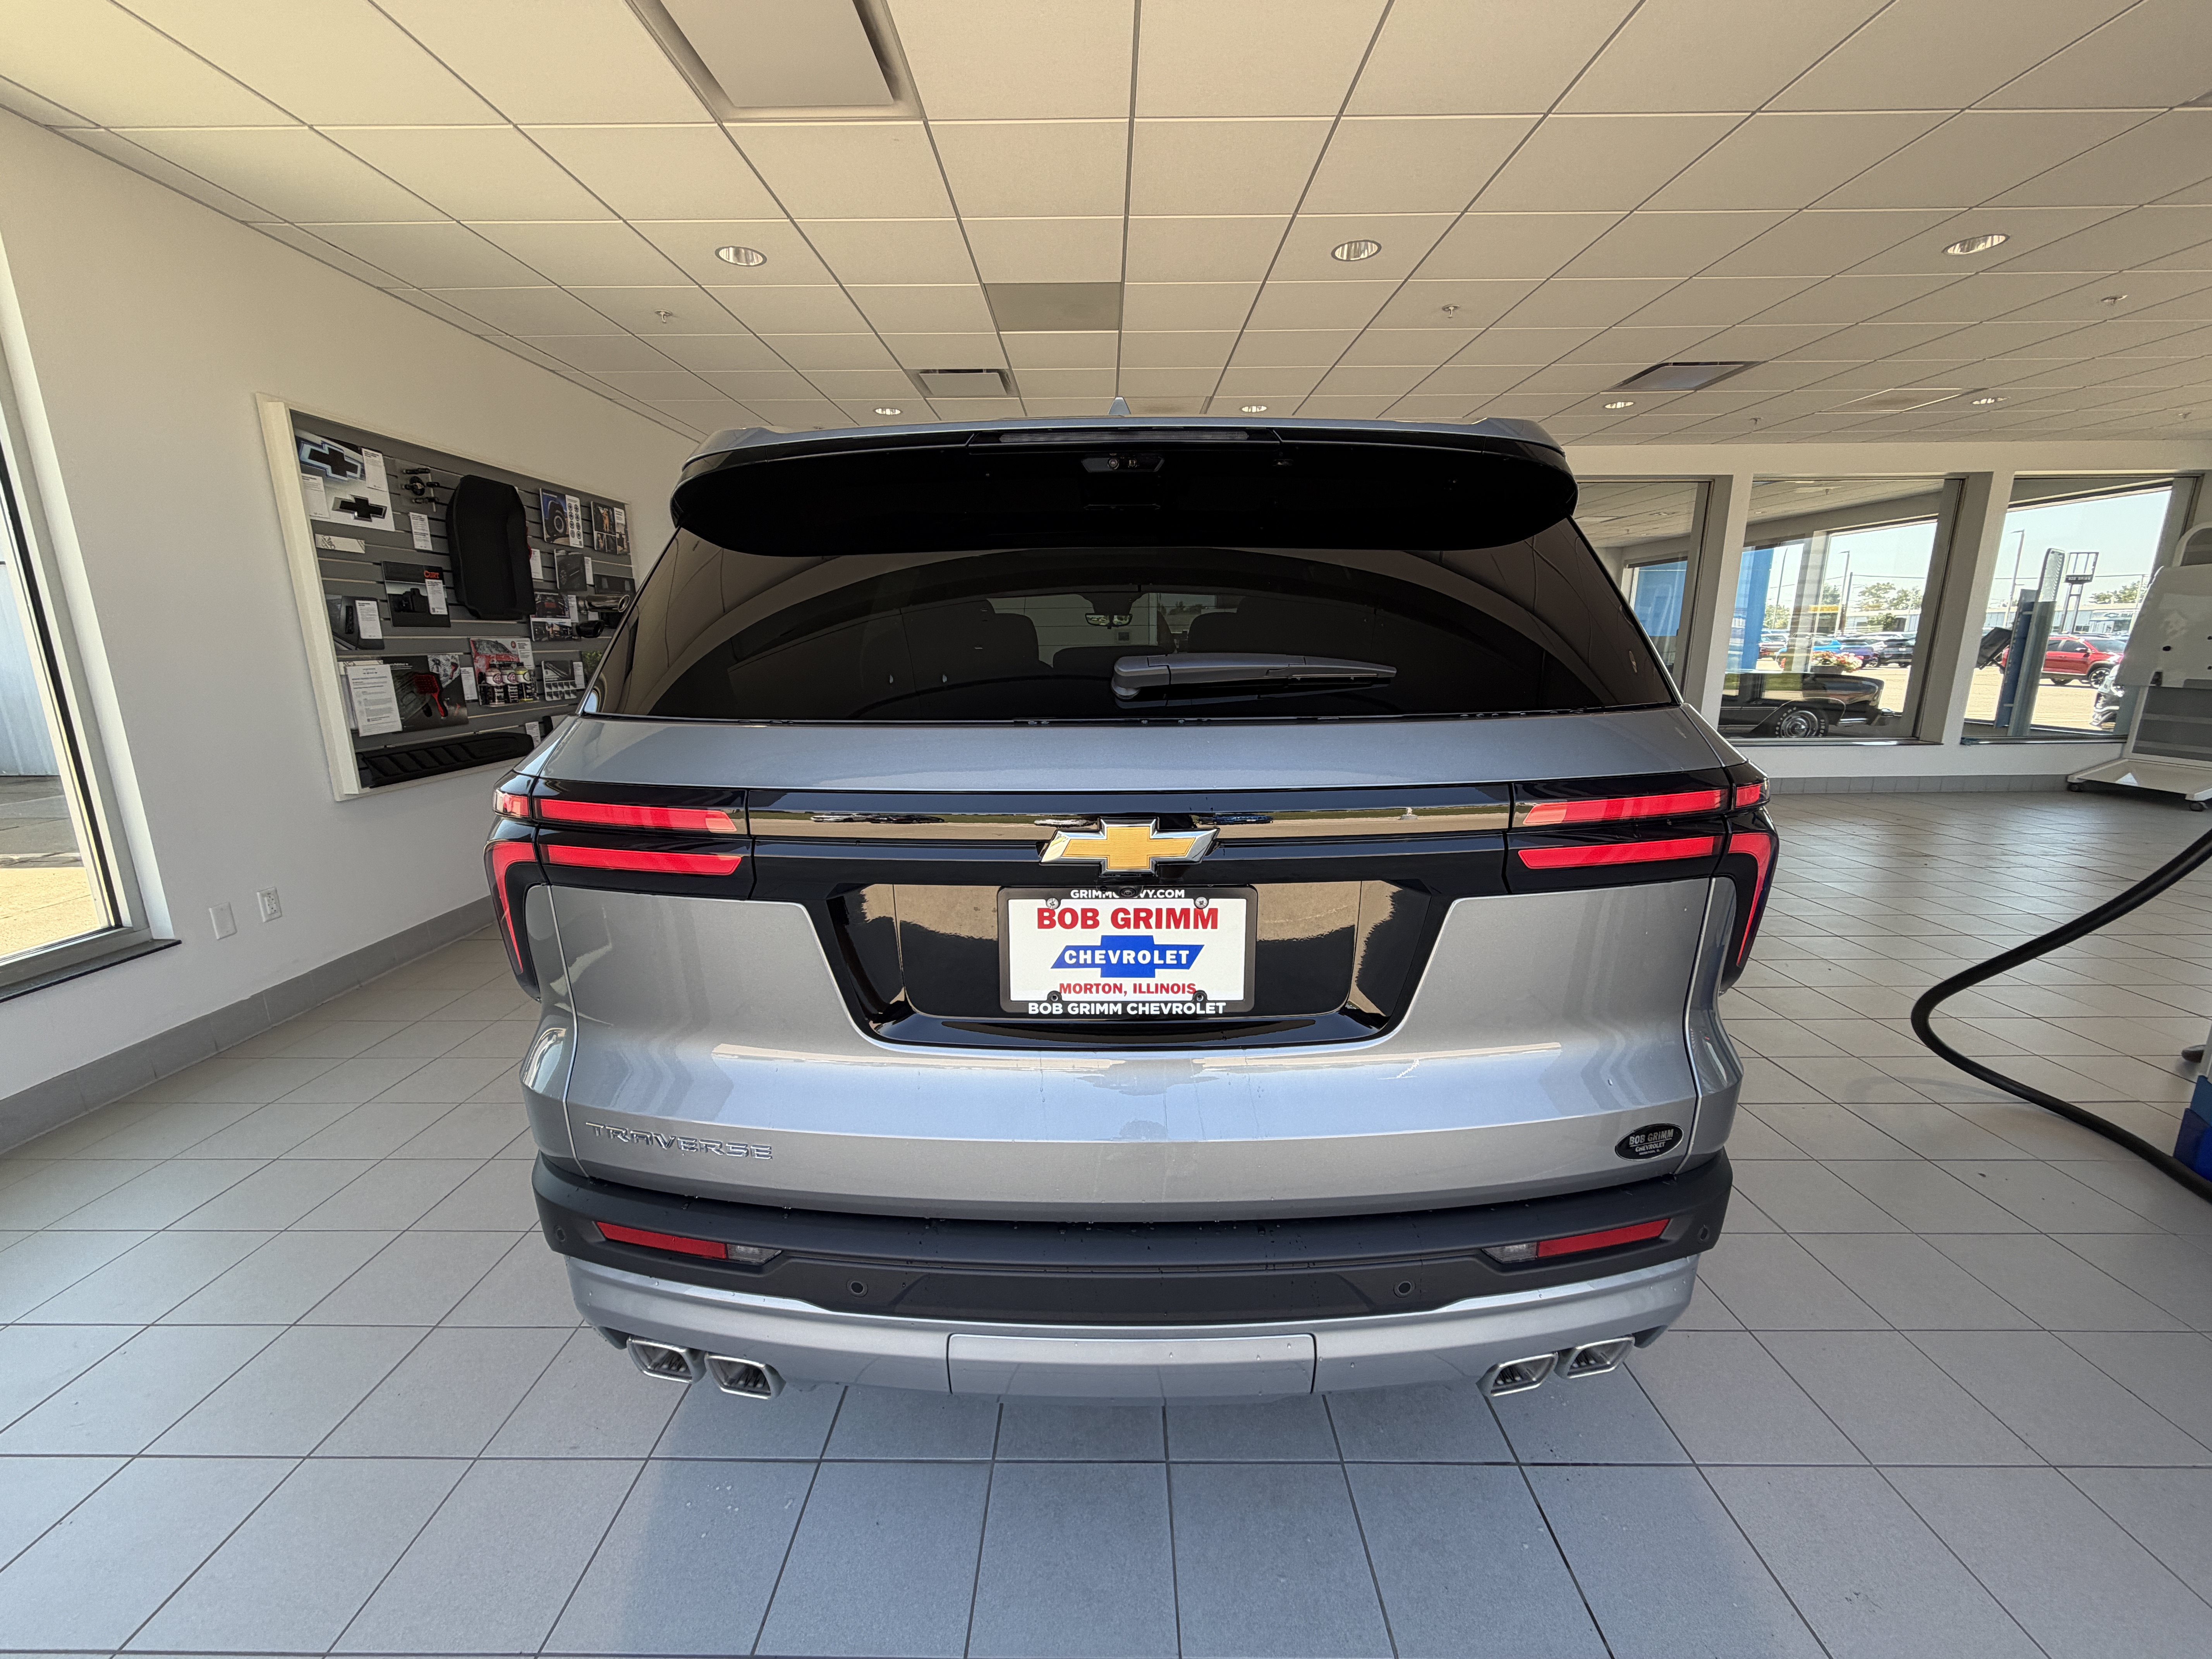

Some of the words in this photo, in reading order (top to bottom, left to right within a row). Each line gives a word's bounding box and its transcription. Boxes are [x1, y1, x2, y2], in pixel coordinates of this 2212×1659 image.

[1070, 890, 1185, 898] GRIMMVY.COM
[1037, 908, 1099, 929] BOB
[1110, 908, 1218, 929] GRIMM
[1064, 950, 1189, 965] CHEVROLET
[1060, 983, 1127, 997] MORTON,
[1133, 983, 1197, 994] ILLINOIS
[1028, 1002, 1063, 1015] BOB
[1067, 1002, 1122, 1015] GRIMM
[1127, 1002, 1227, 1015] CHEVROLET
[586, 1121, 773, 1160] TRAVERSE
[1629, 1135, 1645, 1145] BOB
[1648, 1129, 1673, 1141] GRIMM
[1635, 1141, 1665, 1152] CHEVROLET
